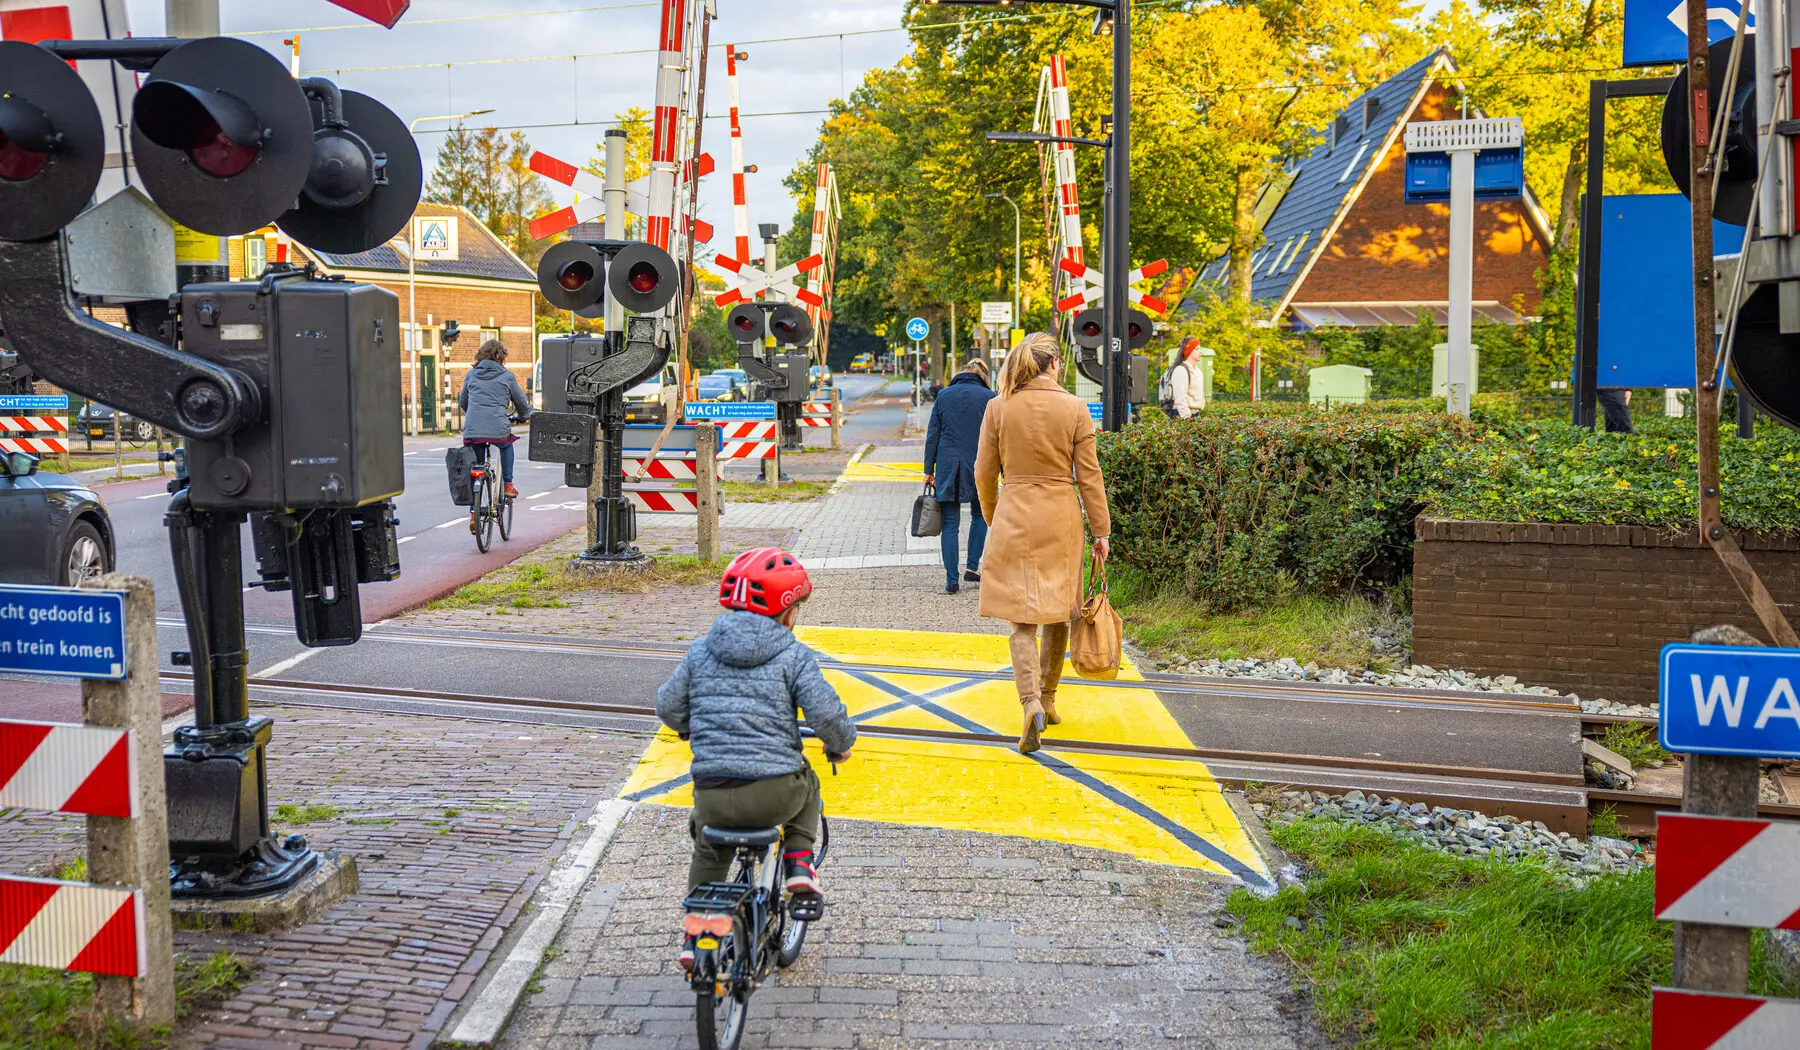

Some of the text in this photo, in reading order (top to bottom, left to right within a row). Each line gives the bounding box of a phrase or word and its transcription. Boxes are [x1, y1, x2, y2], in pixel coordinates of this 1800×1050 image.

[686, 405, 727, 415] WACHT
[29, 604, 94, 625] gedoofd
[99, 607, 112, 624] is
[17, 639, 55, 656] trein
[1690, 673, 1800, 730] WA
